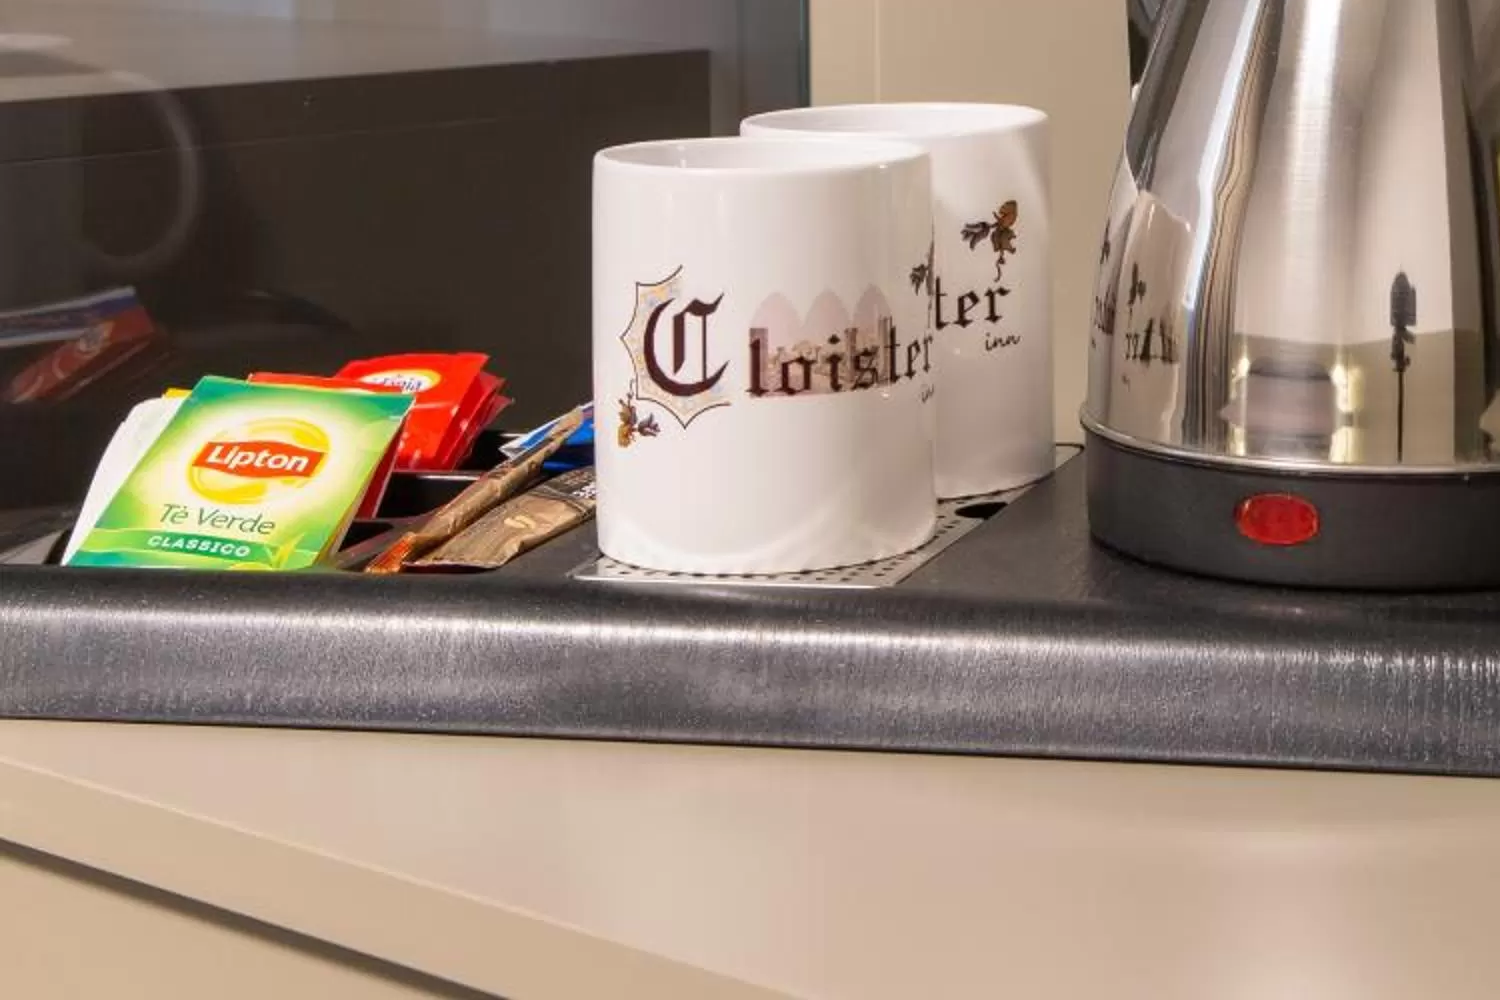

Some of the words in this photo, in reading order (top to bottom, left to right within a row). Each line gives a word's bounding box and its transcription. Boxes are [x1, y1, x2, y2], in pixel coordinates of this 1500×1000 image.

[644, 293, 933, 397] Cloister
[985, 332, 1020, 351] inn
[207, 445, 309, 473] Lipton
[199, 506, 276, 535] Verde
[148, 534, 251, 557] CLASSICO
